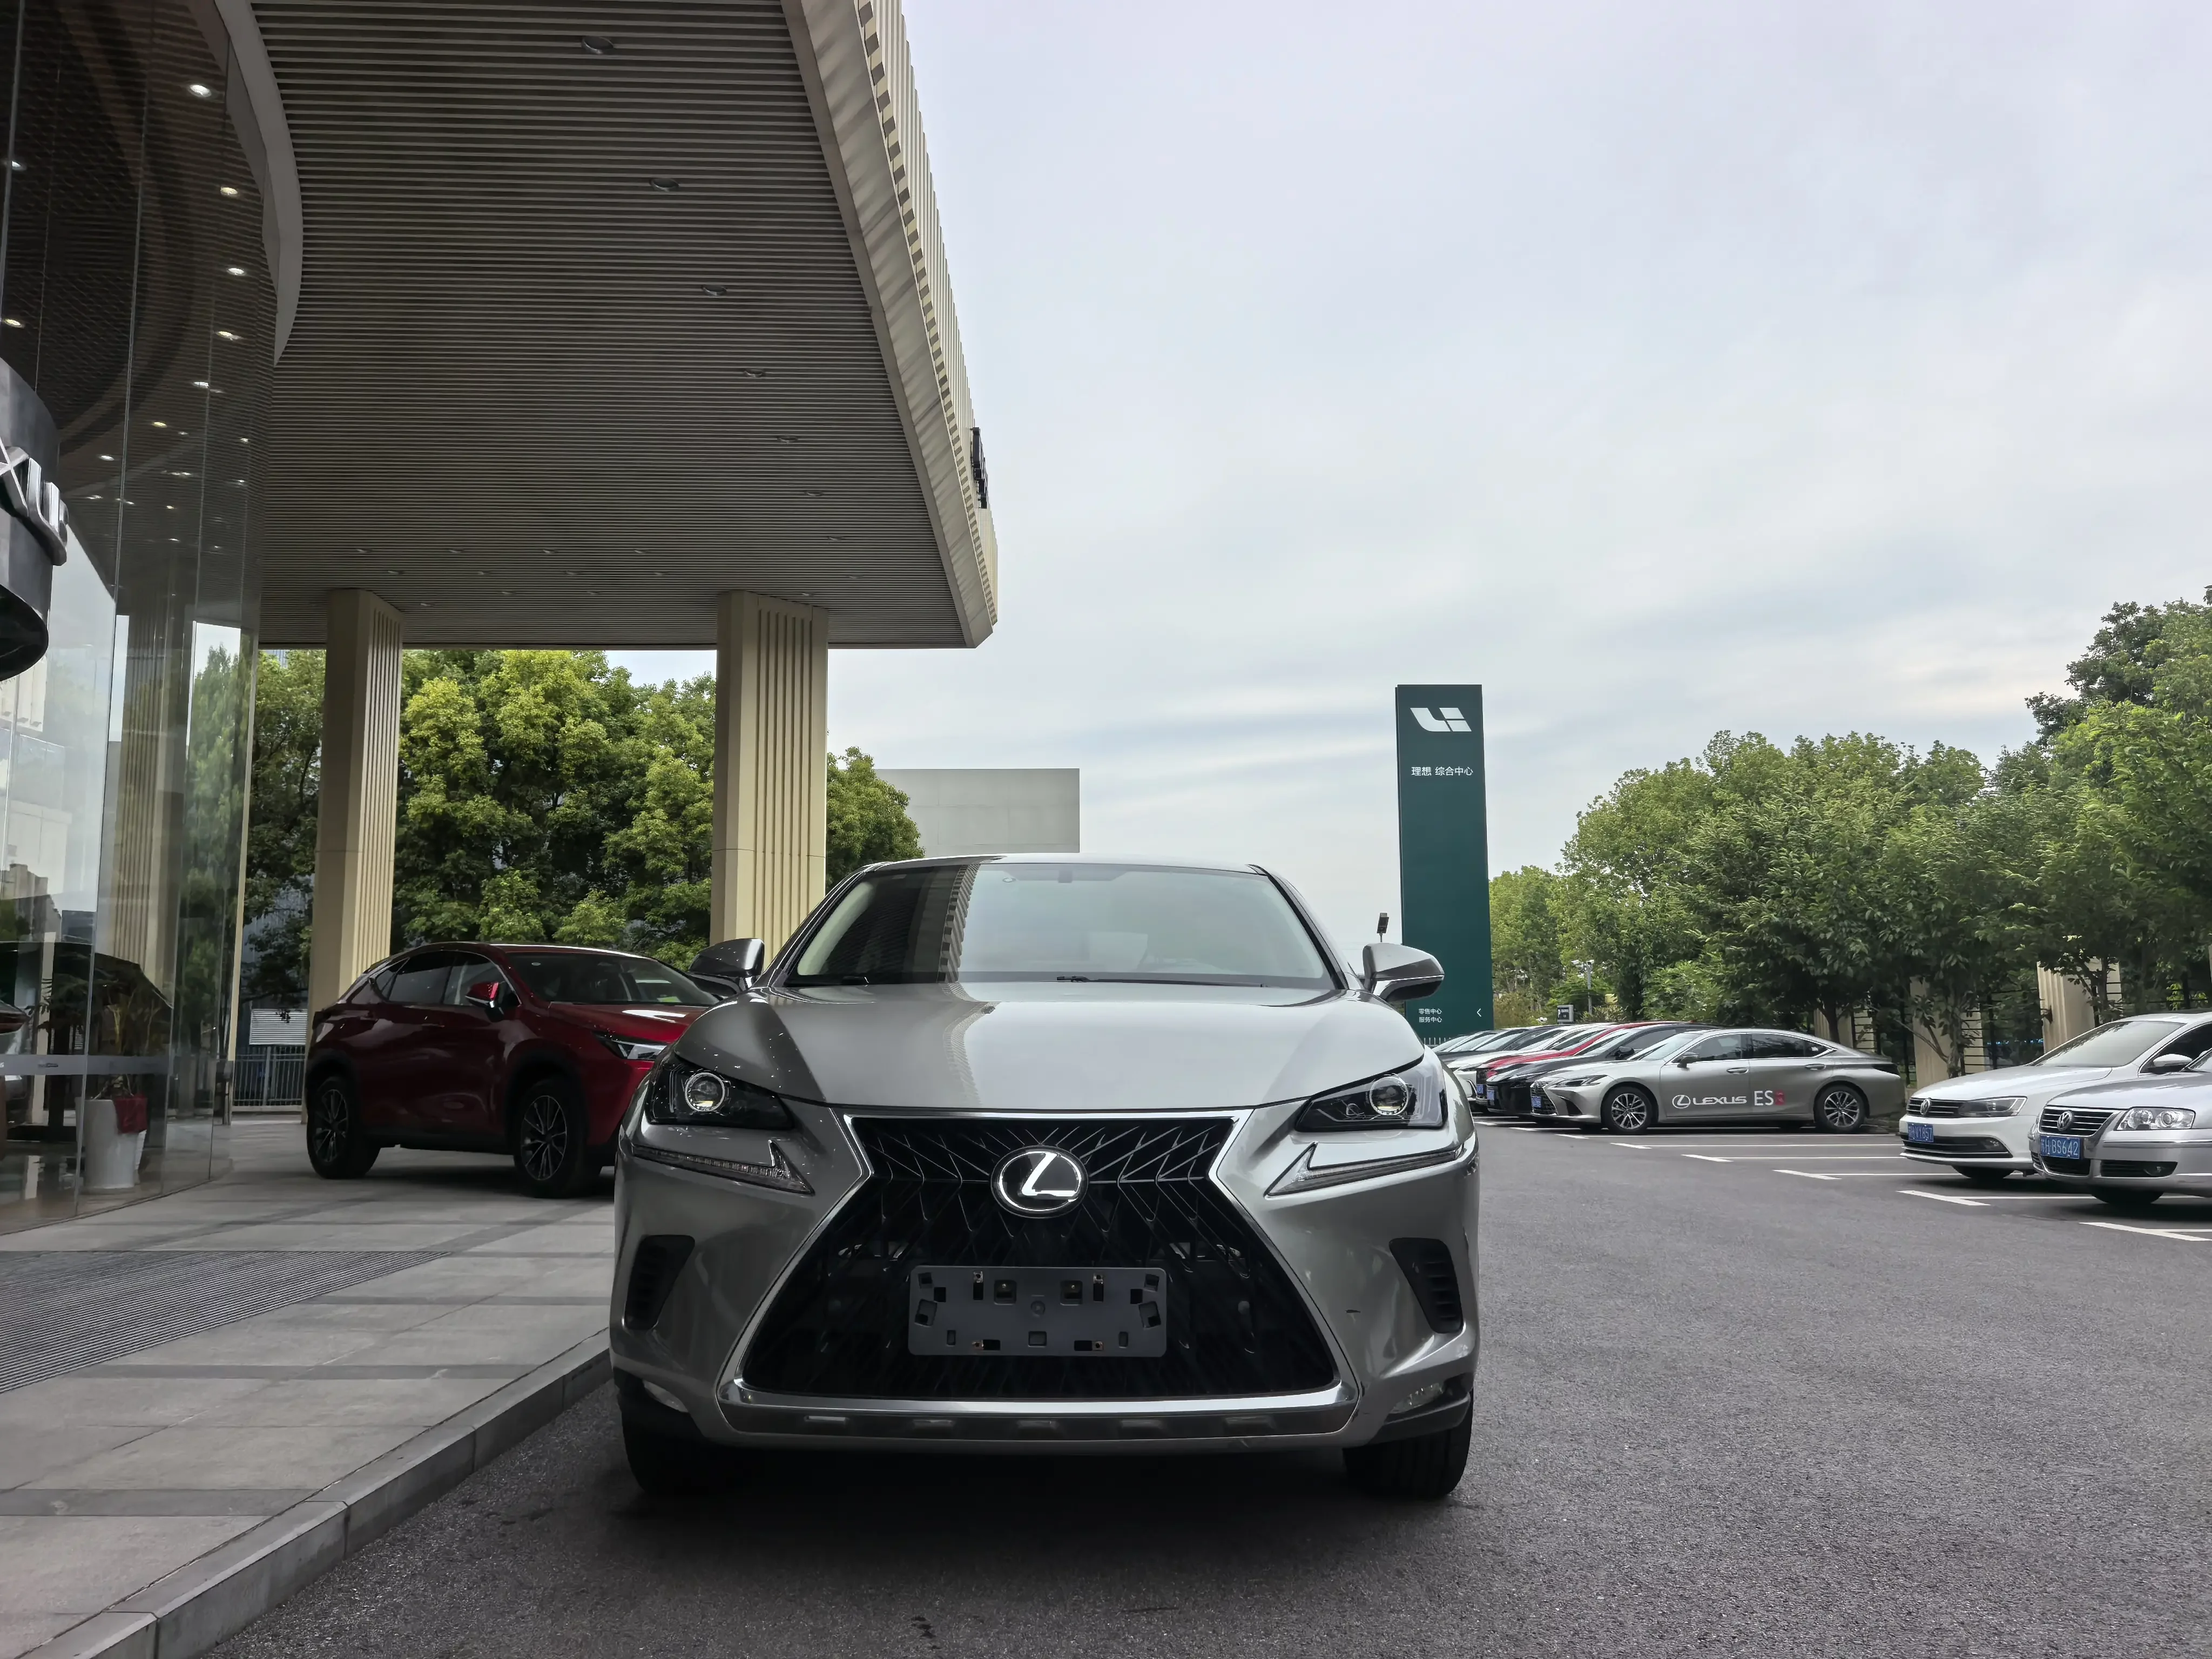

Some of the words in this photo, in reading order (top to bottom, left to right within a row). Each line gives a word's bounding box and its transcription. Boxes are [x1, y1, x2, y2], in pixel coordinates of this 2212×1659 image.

[1411, 766, 1432, 776] 理想
[1435, 766, 1473, 776] 综合中心
[1692, 1096, 1748, 1105] LEXUS
